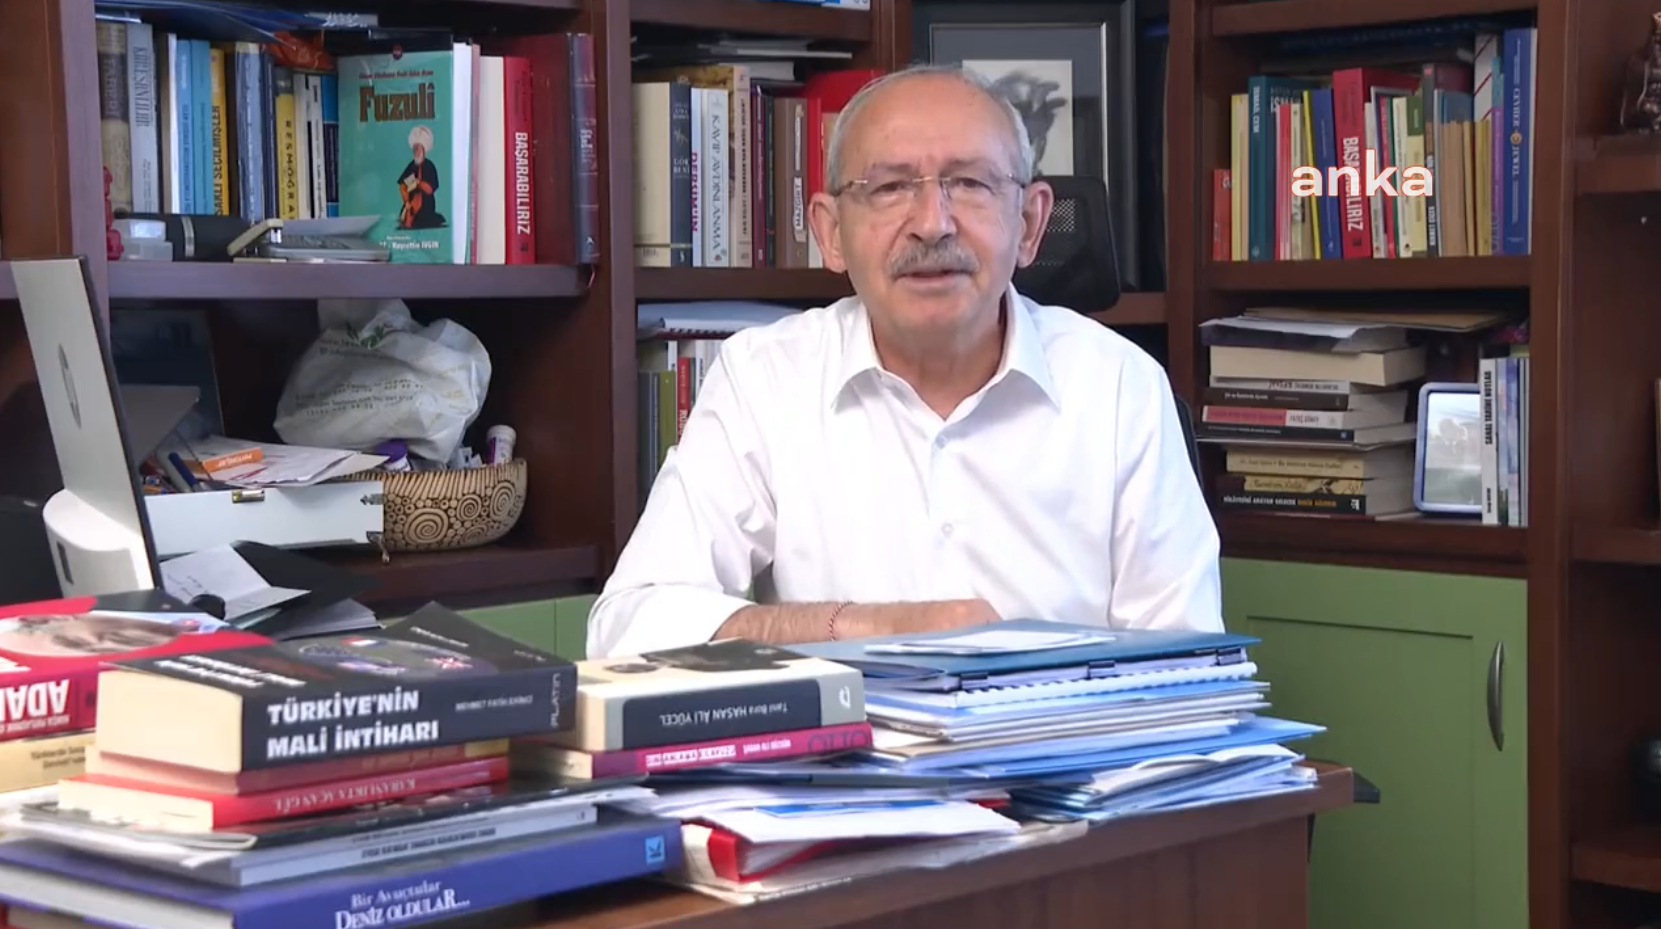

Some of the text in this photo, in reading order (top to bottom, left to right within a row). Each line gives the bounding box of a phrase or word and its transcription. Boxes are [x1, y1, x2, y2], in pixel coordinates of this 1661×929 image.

[267, 687, 419, 726] TÜRKİYE'NİN
[712, 707, 747, 722] HASAN
[267, 721, 440, 759] MALİ İNTİHARI
[351, 893, 373, 909] Bir
